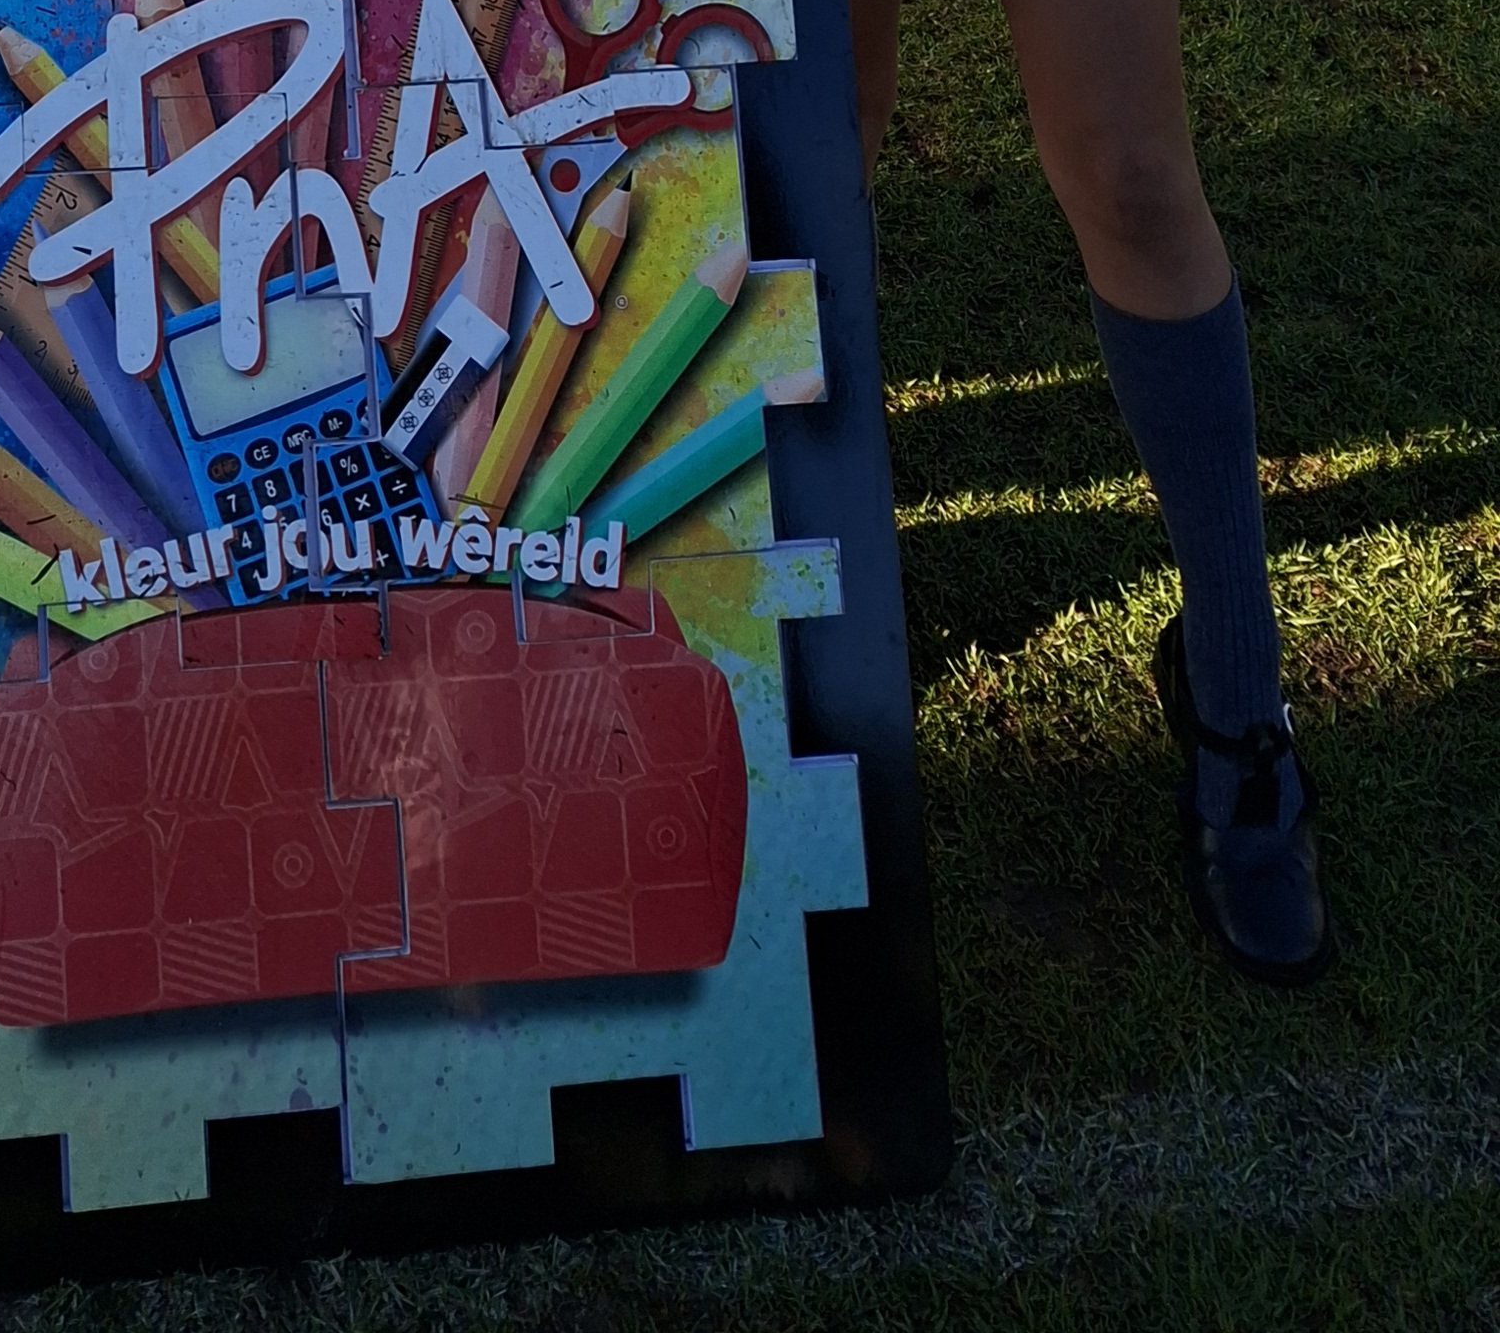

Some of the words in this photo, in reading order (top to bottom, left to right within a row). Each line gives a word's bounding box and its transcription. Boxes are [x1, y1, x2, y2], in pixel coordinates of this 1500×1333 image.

[253, 445, 271, 462] CE
[264, 479, 277, 498] 8
[226, 494, 237, 513] 7
[59, 522, 236, 613] kleur
[256, 506, 376, 592] jou
[398, 505, 626, 589] wêreld
